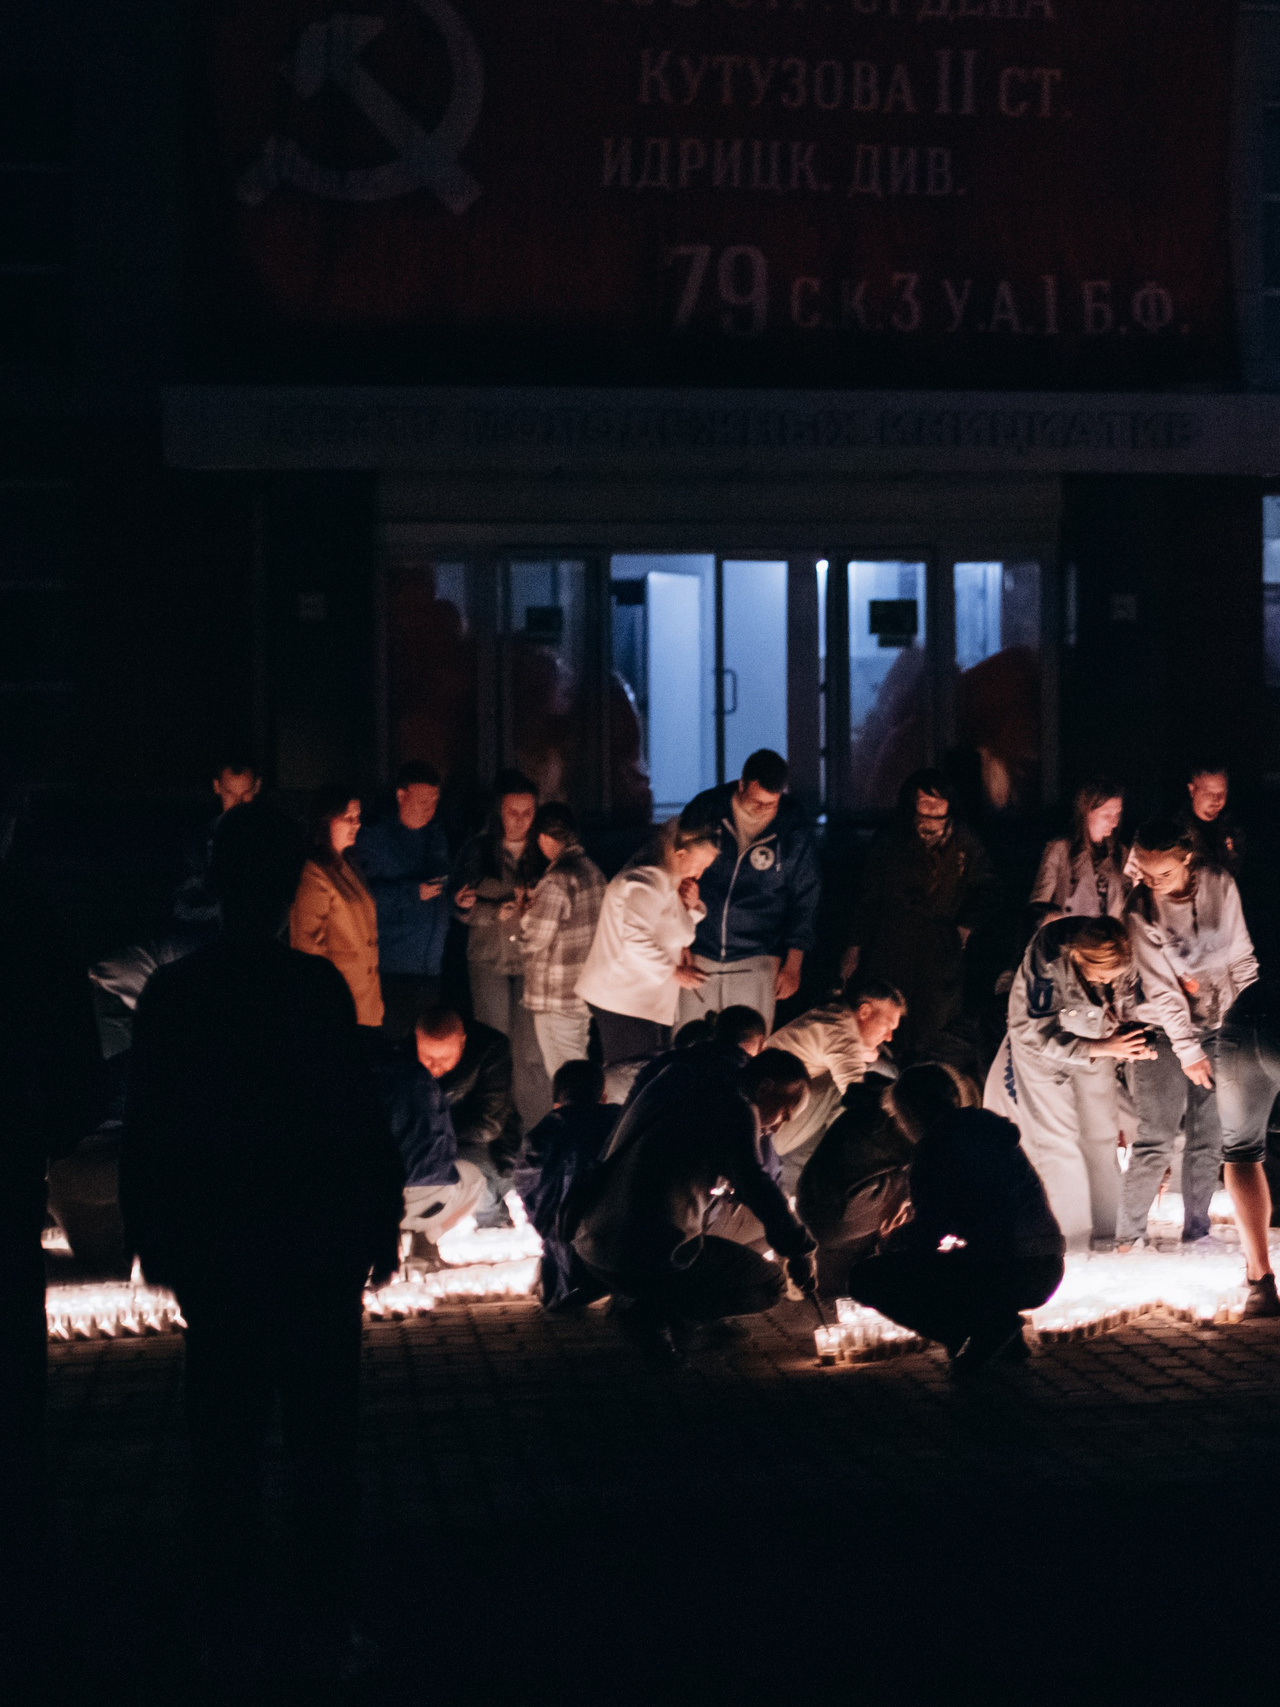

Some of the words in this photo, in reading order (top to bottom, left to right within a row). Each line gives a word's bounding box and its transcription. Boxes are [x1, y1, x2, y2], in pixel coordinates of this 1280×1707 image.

[637, 48, 917, 114] КУТУЗОВА
[998, 66, 1073, 118] СТ.
[600, 137, 833, 193] ИДРИЦК.
[847, 143, 966, 198] ДИВ.
[664, 244, 769, 338] 79
[1082, 279, 1192, 337] Б.Ф.
